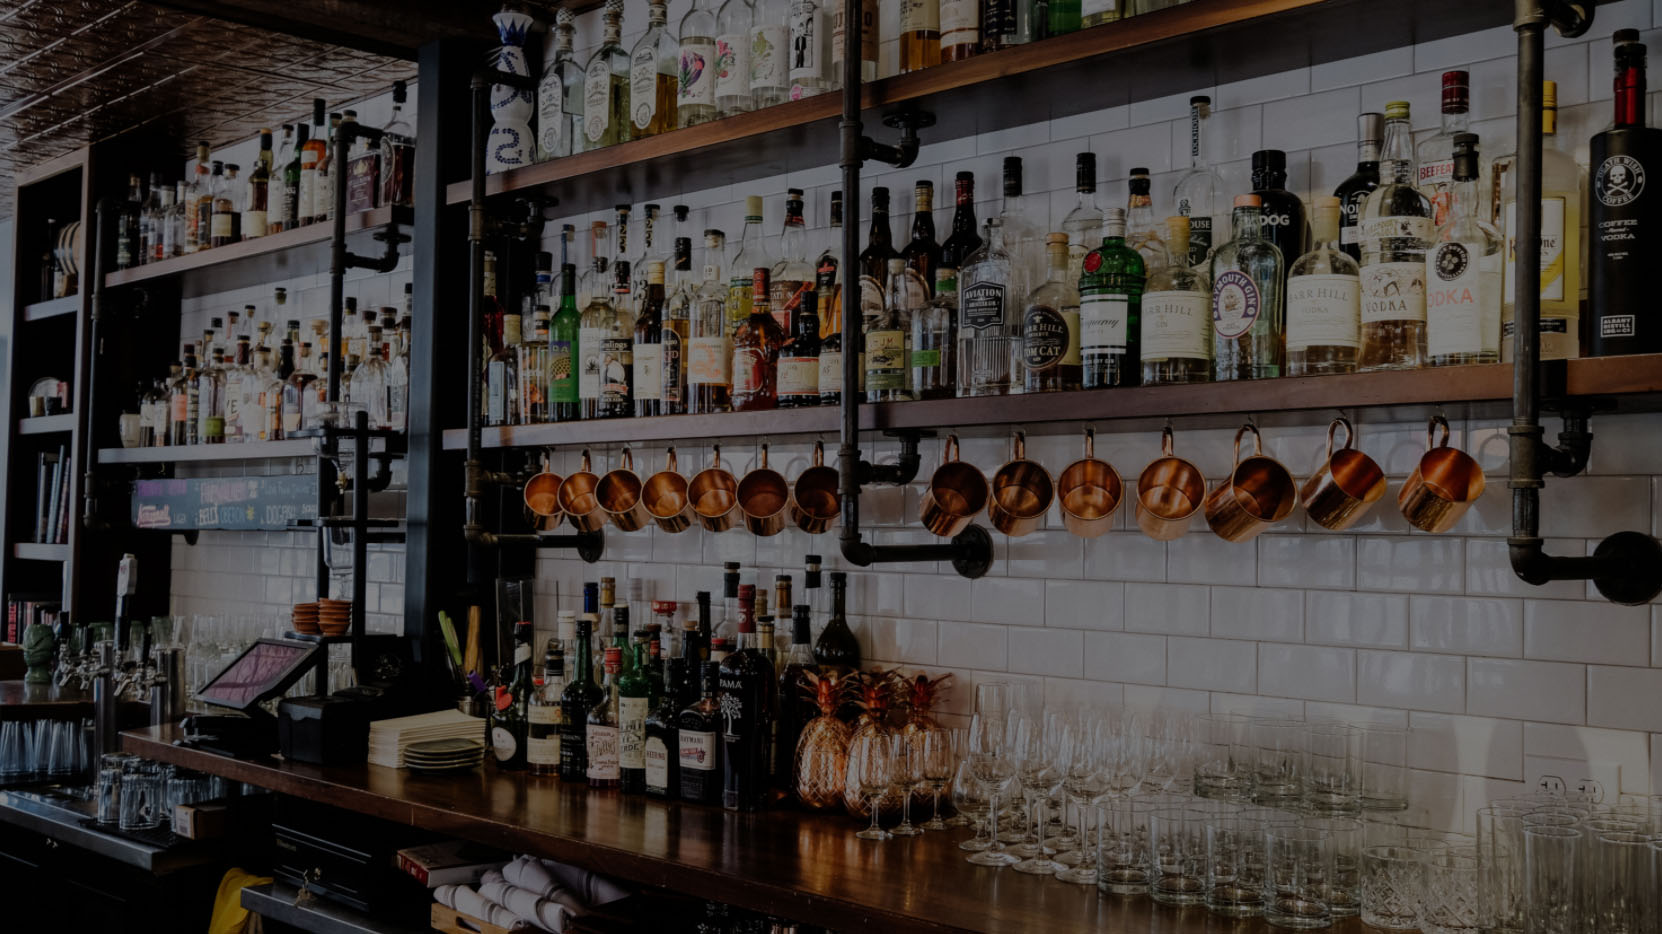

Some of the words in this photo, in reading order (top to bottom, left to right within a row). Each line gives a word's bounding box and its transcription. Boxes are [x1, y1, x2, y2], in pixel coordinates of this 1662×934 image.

[1419, 161, 1454, 180] BEEFEAT
[1602, 191, 1635, 205] COFFEE
[1189, 220, 1211, 230] OUSE
[1259, 214, 1291, 226] DOG
[1598, 219, 1639, 229] COFFEE
[1600, 233, 1635, 242] VODKA
[965, 288, 1002, 299] AVIATION
[1427, 286, 1474, 308] ODKA
[1366, 299, 1408, 313] VODKA
[1039, 345, 1062, 357] CAT
[719, 678, 743, 689] PAMA
